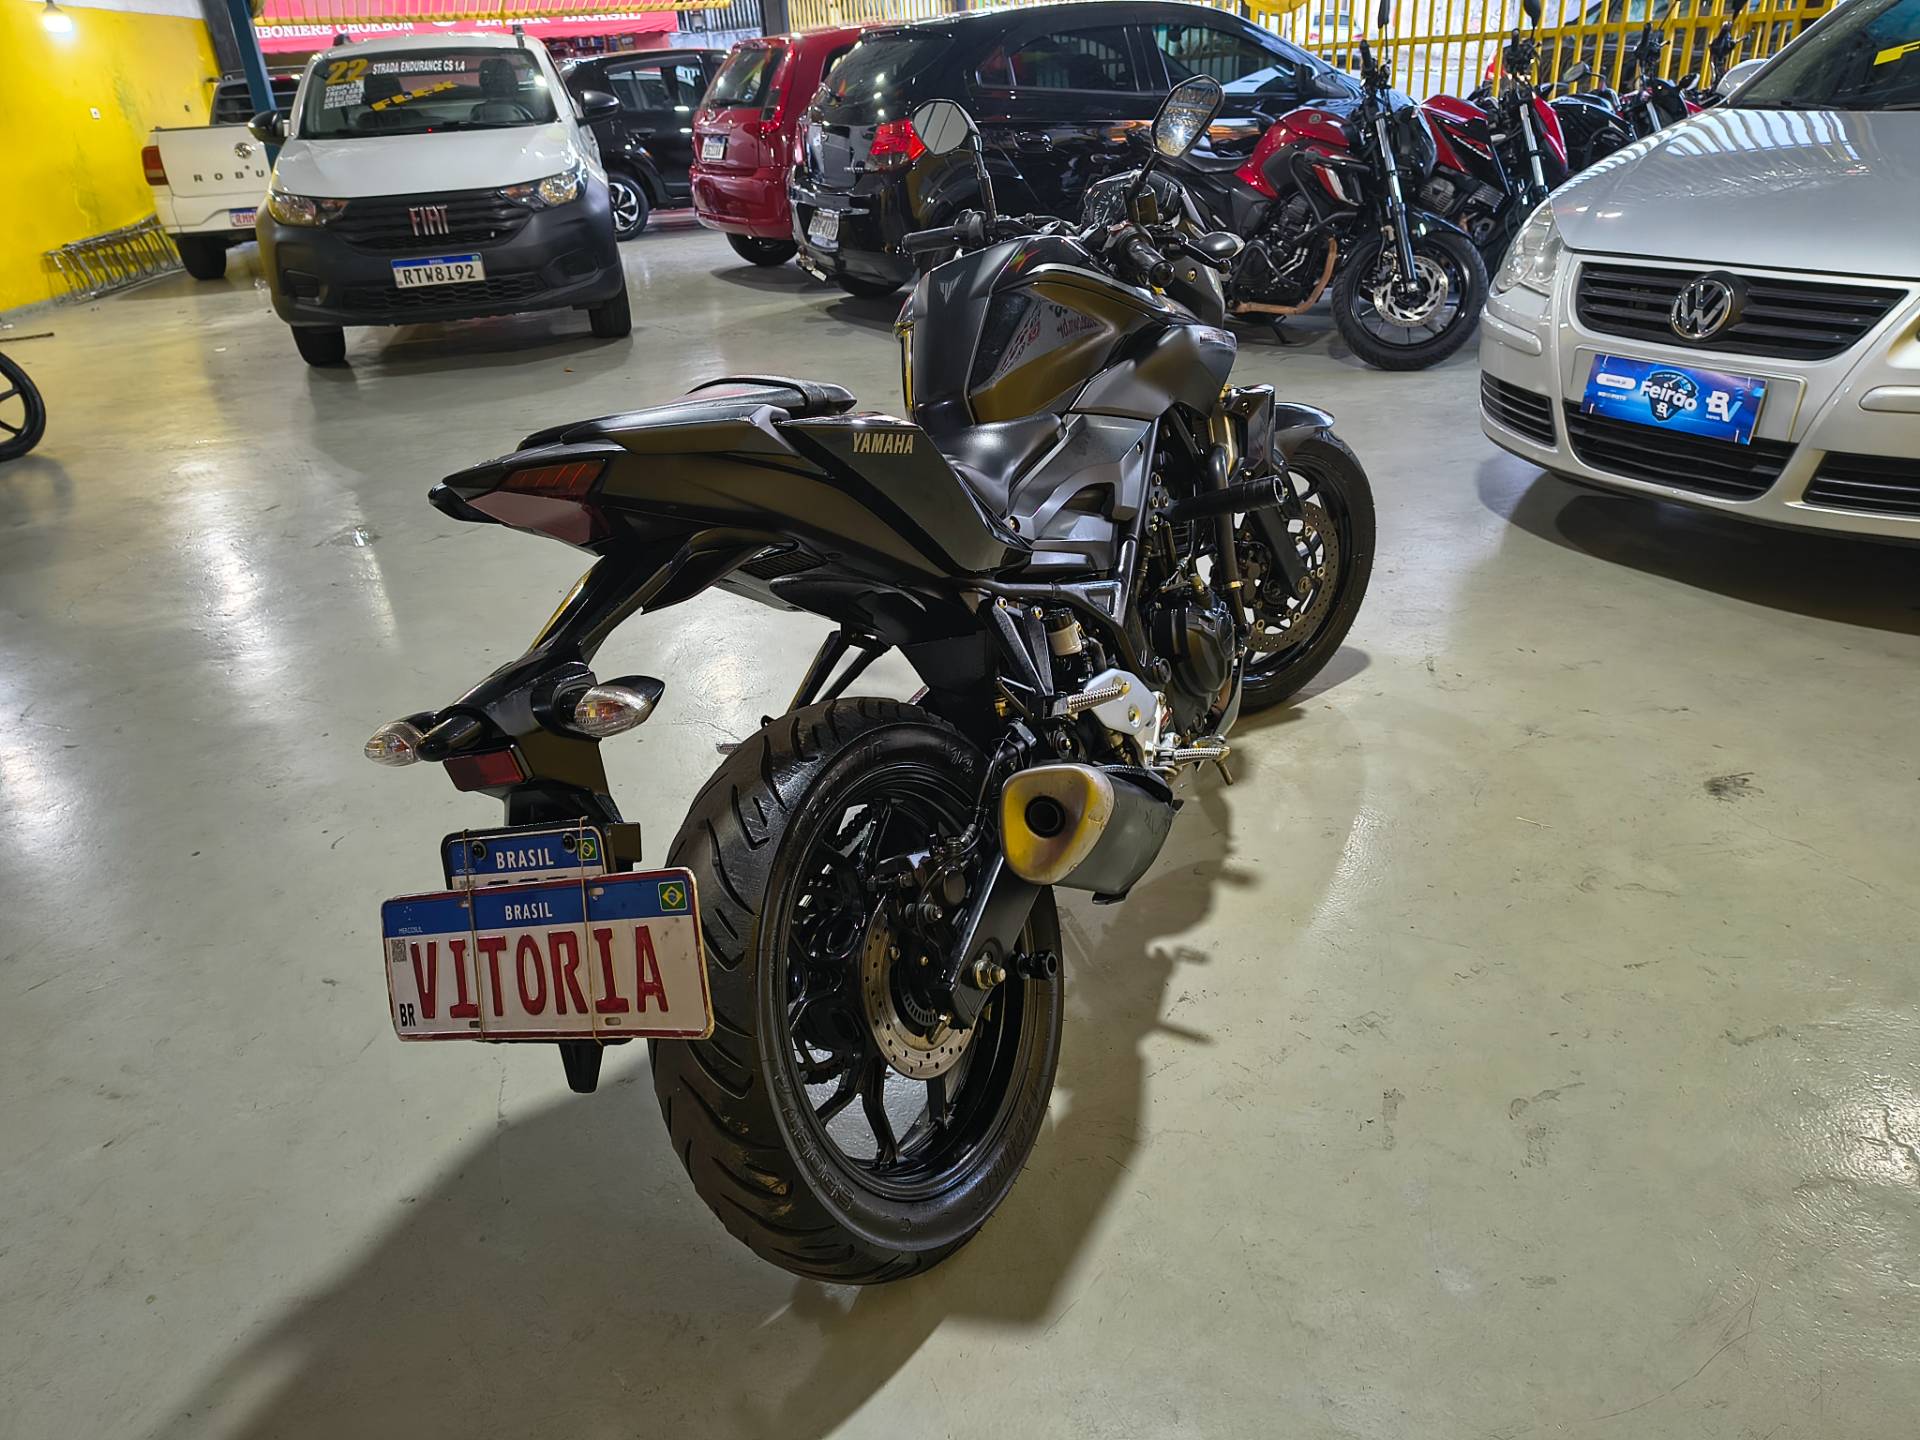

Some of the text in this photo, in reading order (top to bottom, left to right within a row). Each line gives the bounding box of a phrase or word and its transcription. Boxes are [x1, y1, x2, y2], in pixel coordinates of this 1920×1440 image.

[325, 58, 369, 85] 22
[372, 60, 466, 75] STRADA ENDURANCE CS 1.4
[193, 170, 265, 182] ROBU
[408, 205, 449, 236] FIAT
[402, 264, 476, 285] RTW8I92
[1640, 380, 1698, 411] Feirão
[853, 432, 914, 454] YAMAHA
[495, 847, 555, 870] BRASIL
[504, 902, 553, 921] BRASIL
[410, 925, 670, 1019] VITORIA
[399, 1003, 416, 1027] BR
